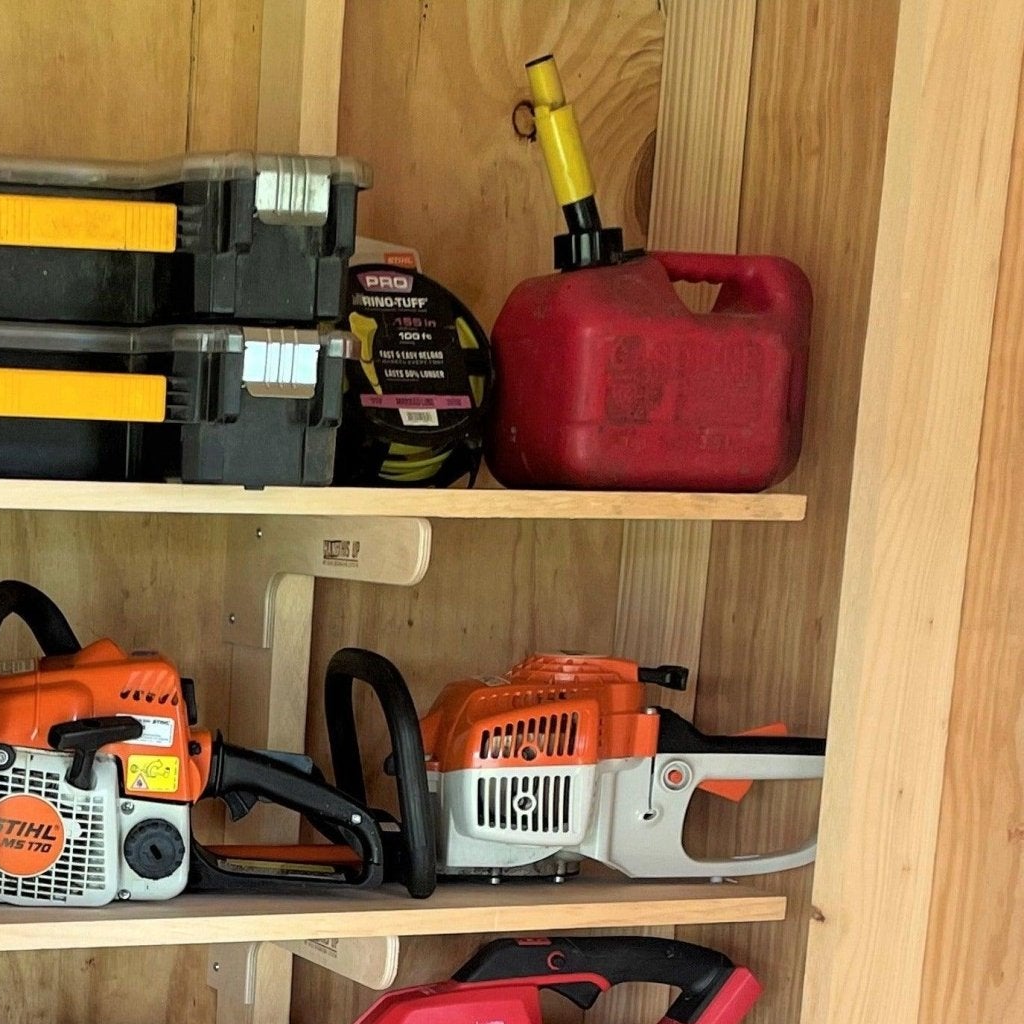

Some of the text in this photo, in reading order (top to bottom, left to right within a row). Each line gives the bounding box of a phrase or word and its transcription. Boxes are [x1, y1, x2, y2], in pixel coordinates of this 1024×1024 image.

[365, 275, 408, 289] PRO
[398, 331, 420, 340] 100
[0, 838, 52, 853] MS 170
